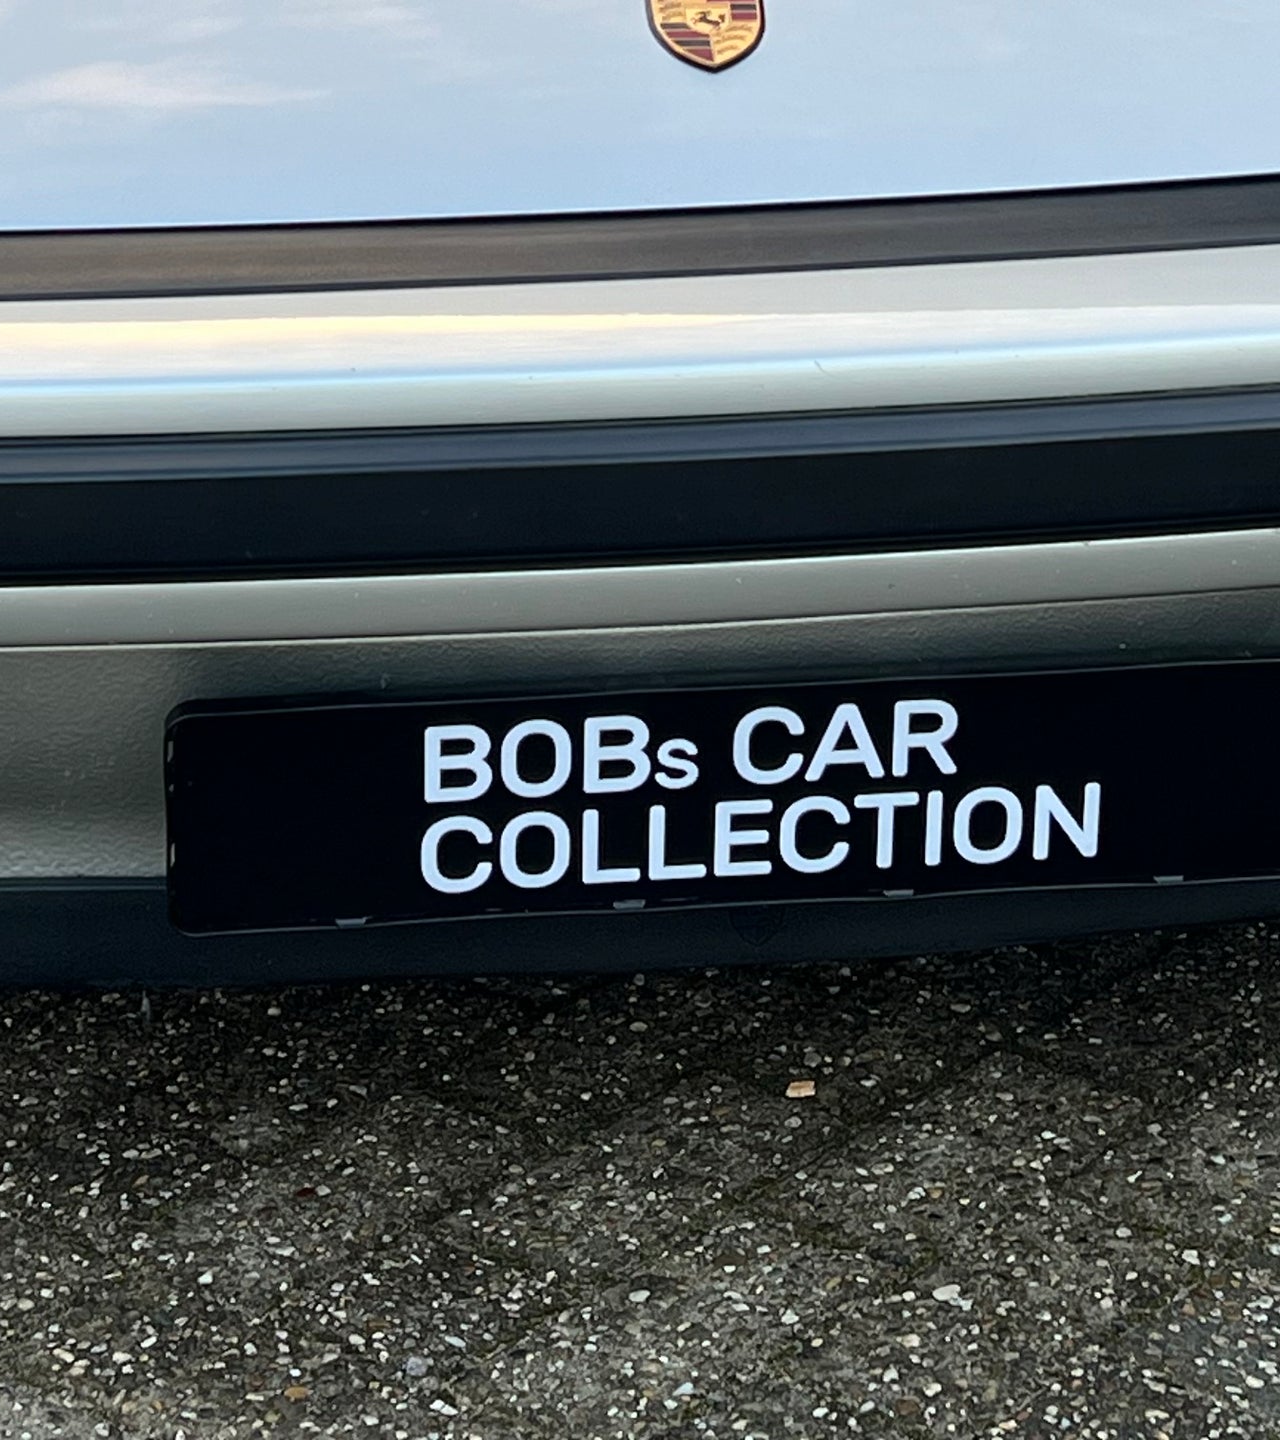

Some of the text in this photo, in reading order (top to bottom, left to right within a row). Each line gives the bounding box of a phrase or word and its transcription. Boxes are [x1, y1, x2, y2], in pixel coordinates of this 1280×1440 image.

[425, 700, 958, 803] BOBs CAR
[421, 782, 1100, 893] COLLECTION
